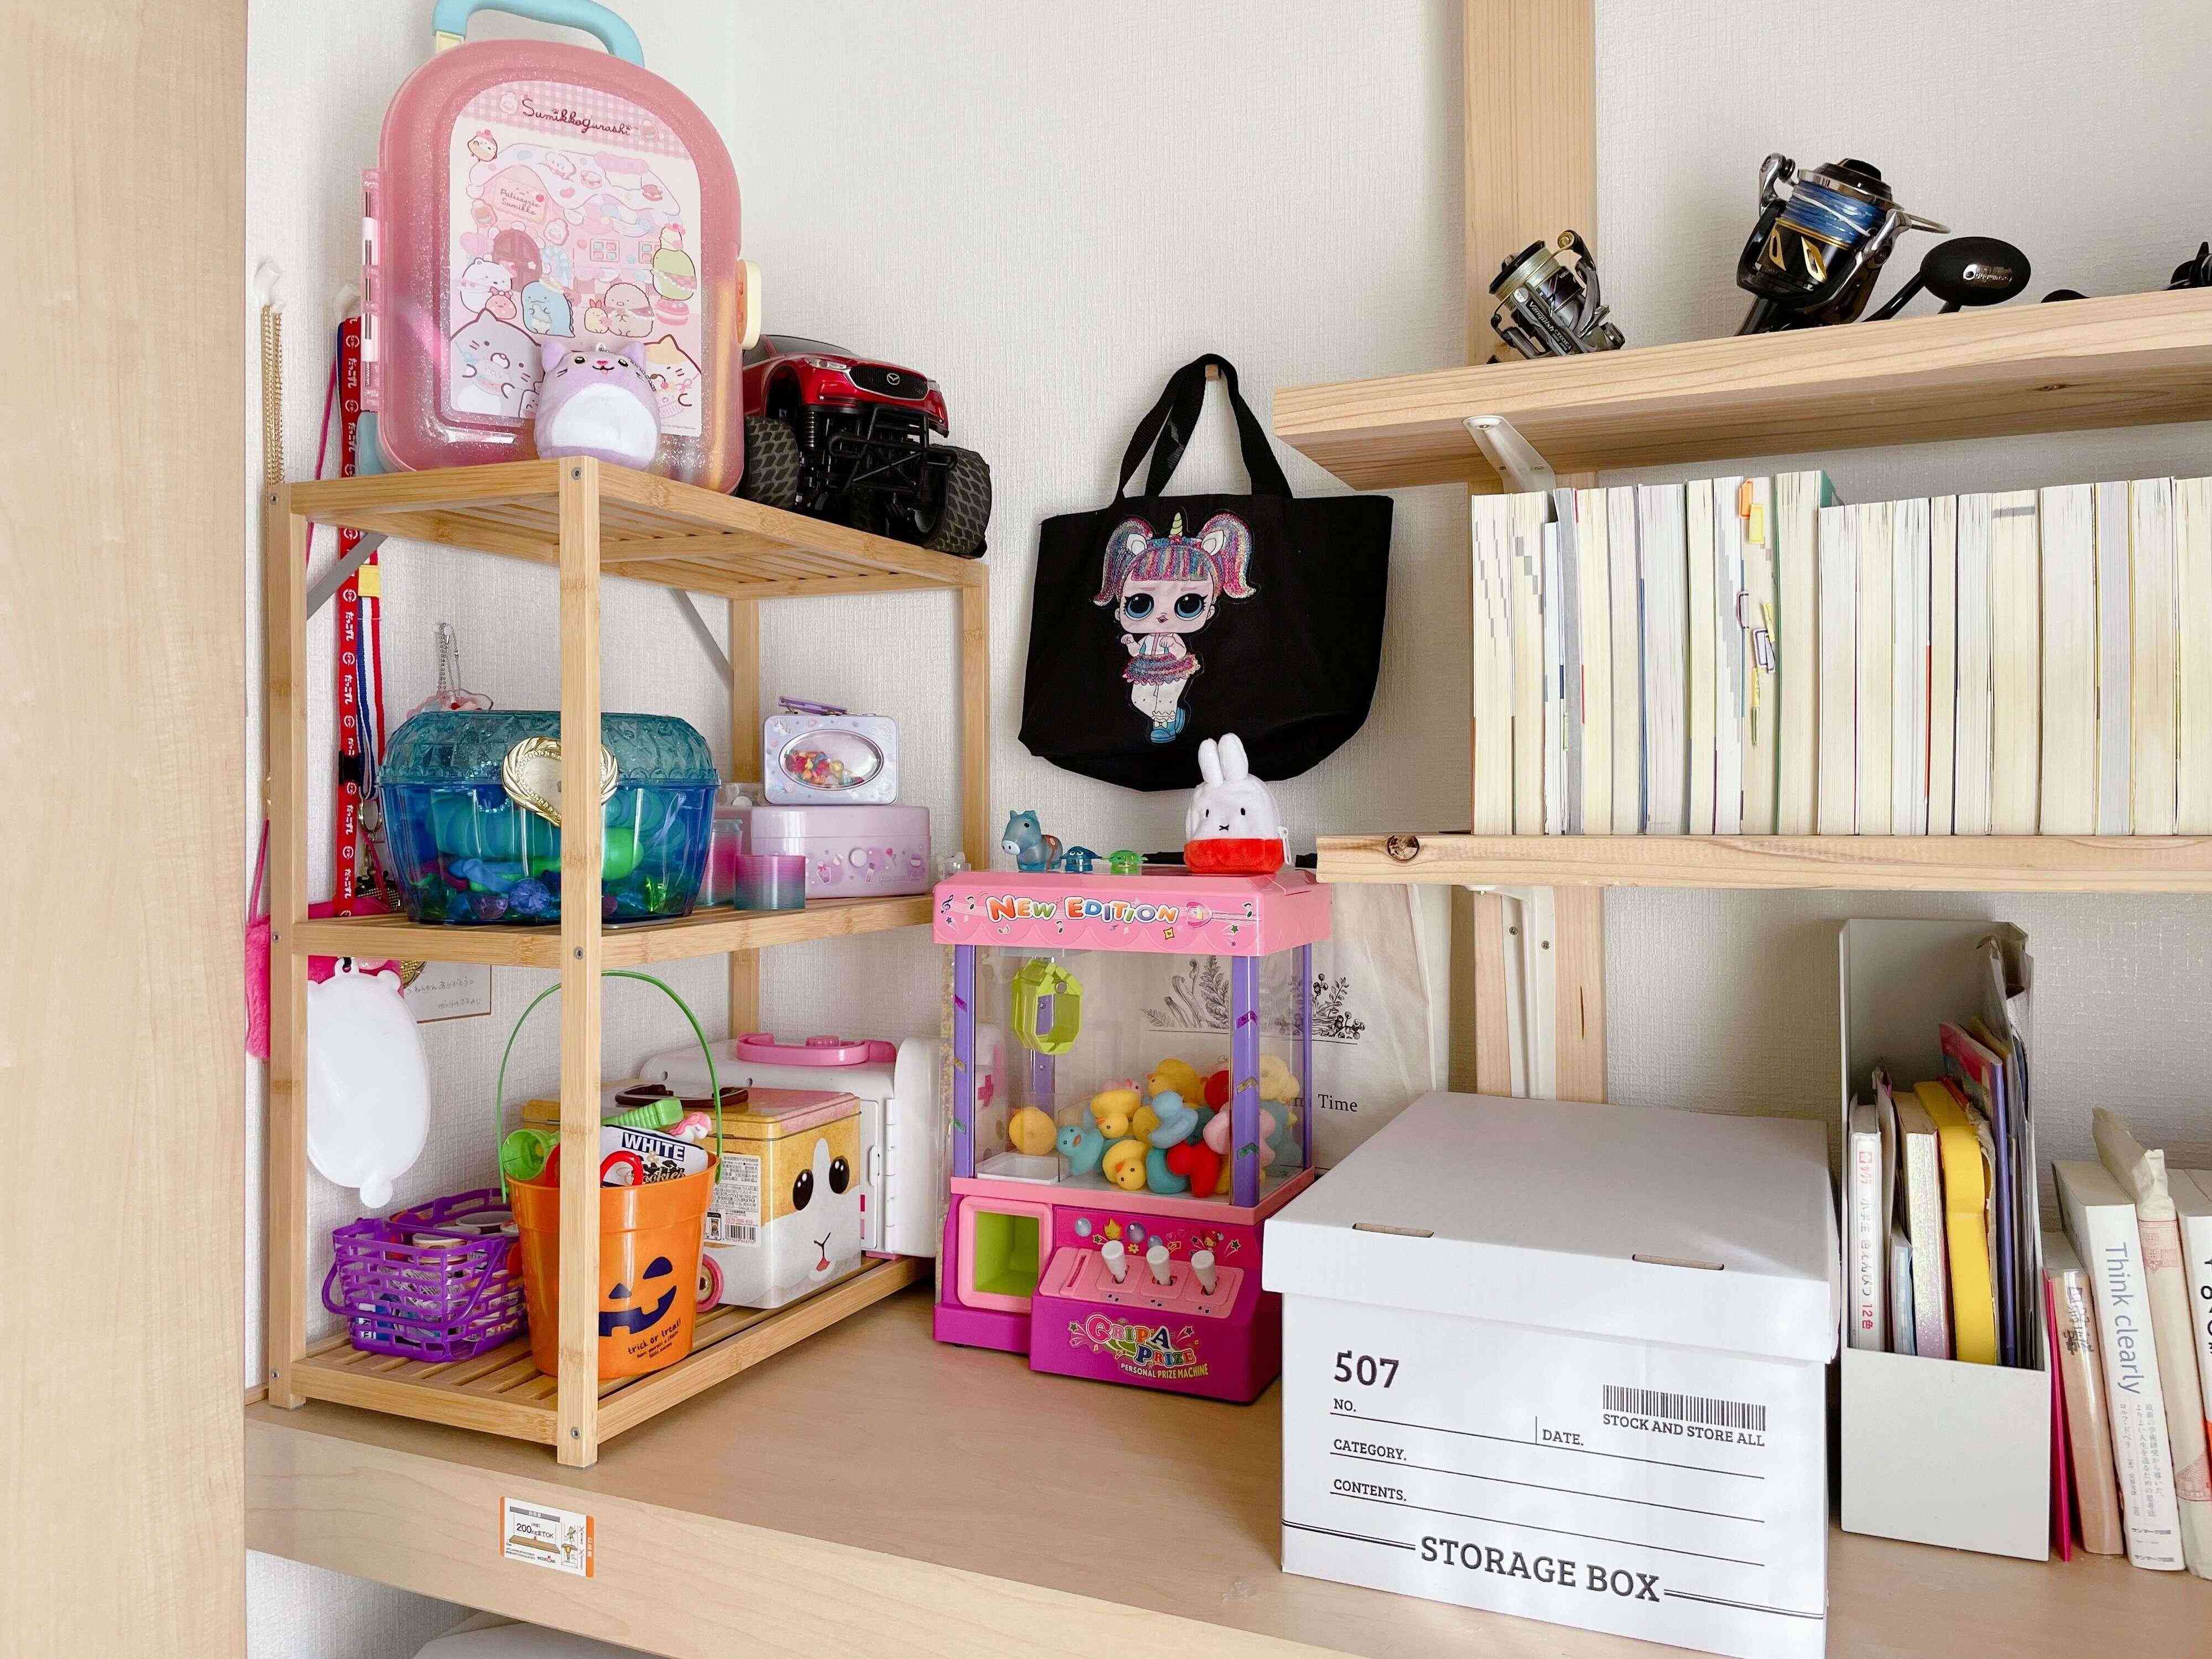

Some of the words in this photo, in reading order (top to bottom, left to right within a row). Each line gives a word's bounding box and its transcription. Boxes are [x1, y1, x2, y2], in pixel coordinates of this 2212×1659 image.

[522, 97, 630, 136] Sumikkogurashi
[1528, 301, 1554, 332] Vanquish
[987, 895, 1056, 922] NEW
[1065, 896, 1180, 924] EDITION
[1317, 1093, 1358, 1113] Time
[624, 1132, 685, 1161] WHITE
[1861, 1239, 1872, 1296] 色えんぴつ
[2105, 1241, 2128, 1306] Think
[1861, 1303, 1874, 1329] 12色
[628, 1340, 649, 1354] trick
[650, 1334, 659, 1344] or
[661, 1317, 681, 1337] treat!
[1134, 1343, 1196, 1368] PRIZE
[2114, 1315, 2145, 1394] clearly
[1121, 1363, 1156, 1378] PERSONAL
[1157, 1369, 1177, 1379] PRIZE
[1177, 1363, 1208, 1379] MACHINE
[1334, 1350, 1400, 1389] 507
[1333, 1398, 1357, 1413] NO.
[1542, 1429, 1584, 1447] DATE.
[1603, 1413, 1650, 1432] STOCK
[1651, 1421, 1684, 1436] AND
[1687, 1425, 1734, 1443] STORE
[1736, 1432, 1766, 1447] ALL
[1333, 1438, 1407, 1461] CATEGORY.
[1333, 1478, 1407, 1501] CONTENTS.
[1420, 1535, 1577, 1588] STORAGE
[1586, 1564, 1661, 1602] BOX
